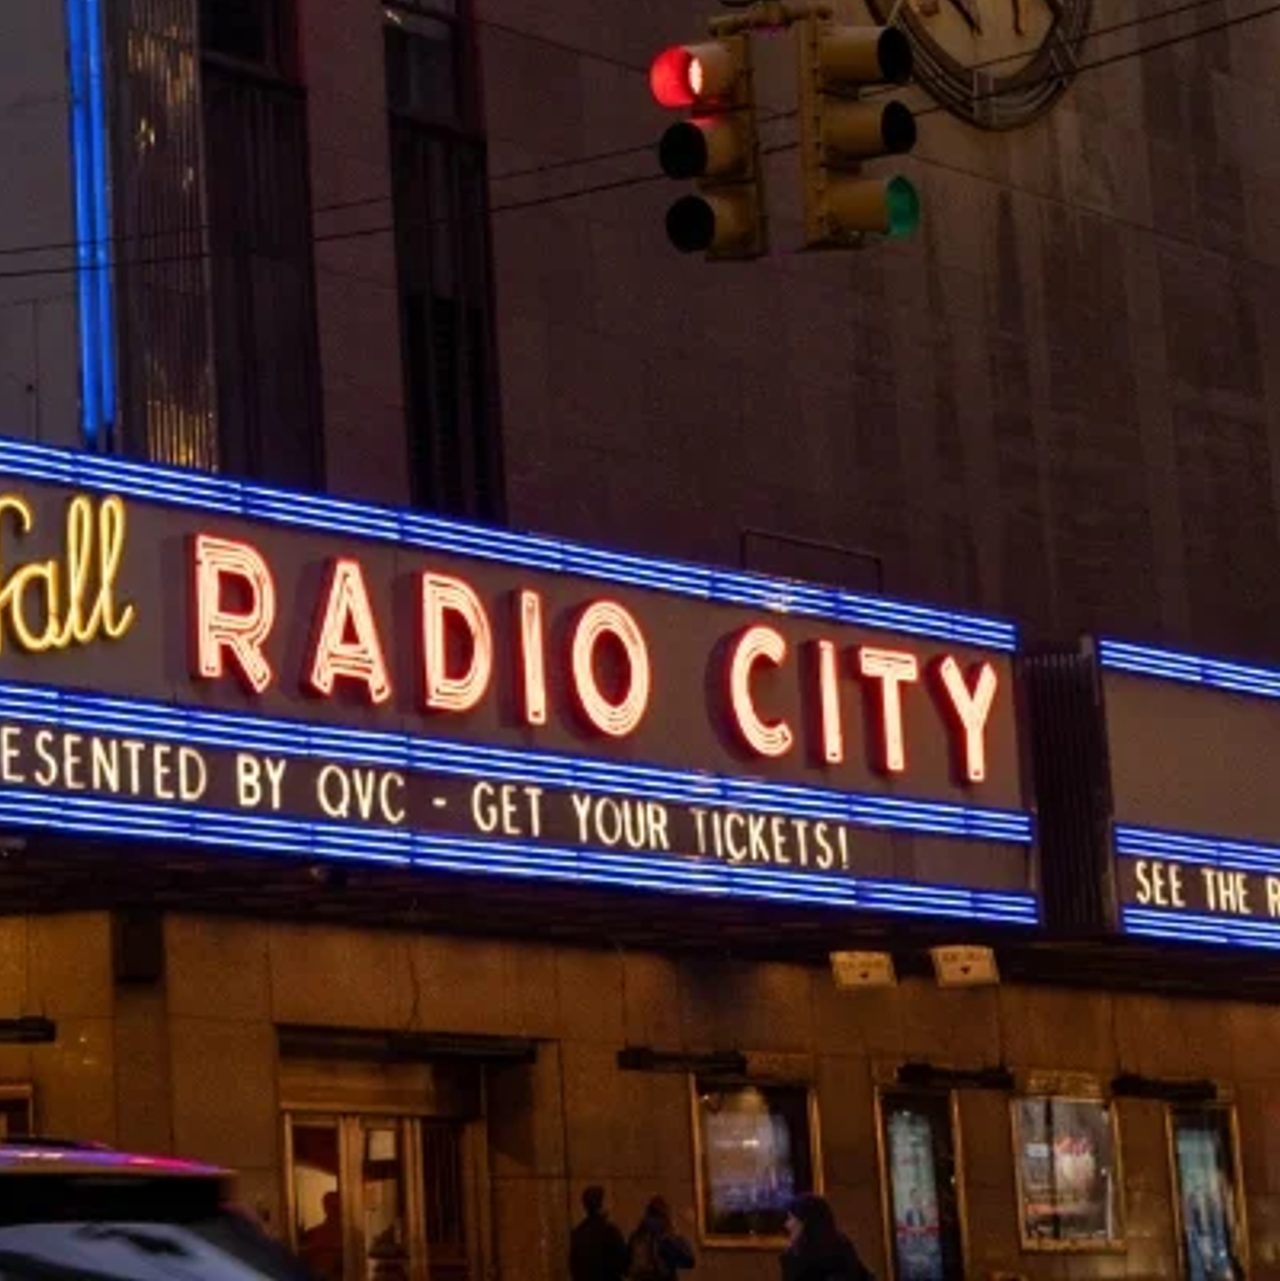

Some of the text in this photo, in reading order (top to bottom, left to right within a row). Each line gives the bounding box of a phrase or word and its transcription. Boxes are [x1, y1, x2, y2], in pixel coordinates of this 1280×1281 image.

[192, 532, 651, 738] RADIO
[726, 623, 999, 784] CITY
[236, 753, 286, 810] BY
[316, 765, 406, 823] QVC
[472, 782, 542, 838] GET
[571, 796, 670, 850] YOUR
[690, 806, 848, 870] TICKETS!
[1135, 859, 1187, 908] SEE
[1200, 867, 1252, 915] THE
